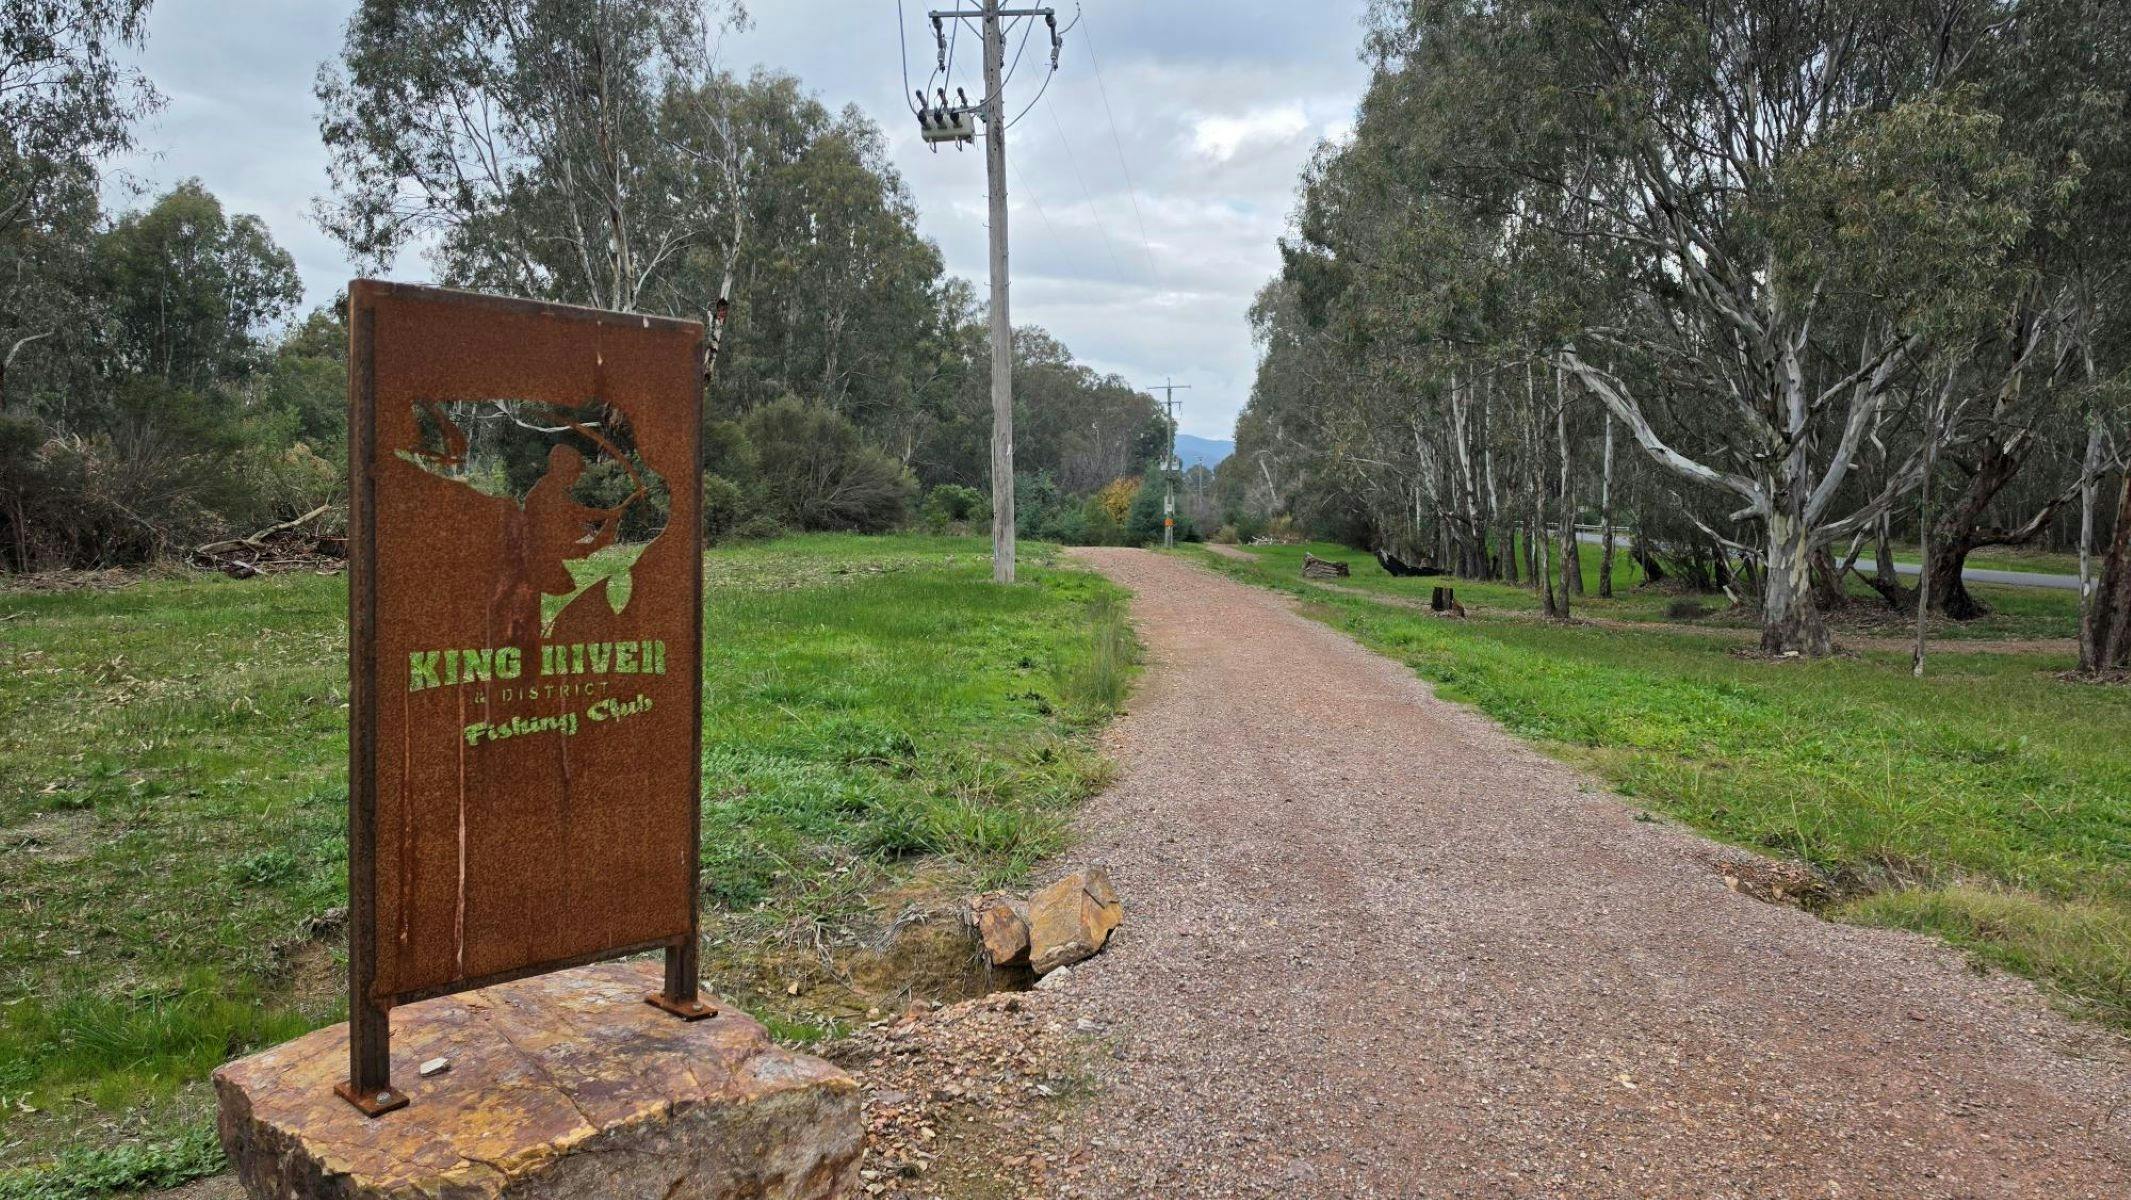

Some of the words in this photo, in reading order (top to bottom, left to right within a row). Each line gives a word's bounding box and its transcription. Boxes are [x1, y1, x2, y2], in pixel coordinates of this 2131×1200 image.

[409, 647, 521, 692] KING
[541, 640, 666, 676] RIVER
[474, 692, 486, 703] &
[502, 681, 609, 701] DISTRICT
[463, 712, 578, 746] Fishing
[587, 694, 653, 722] Club
